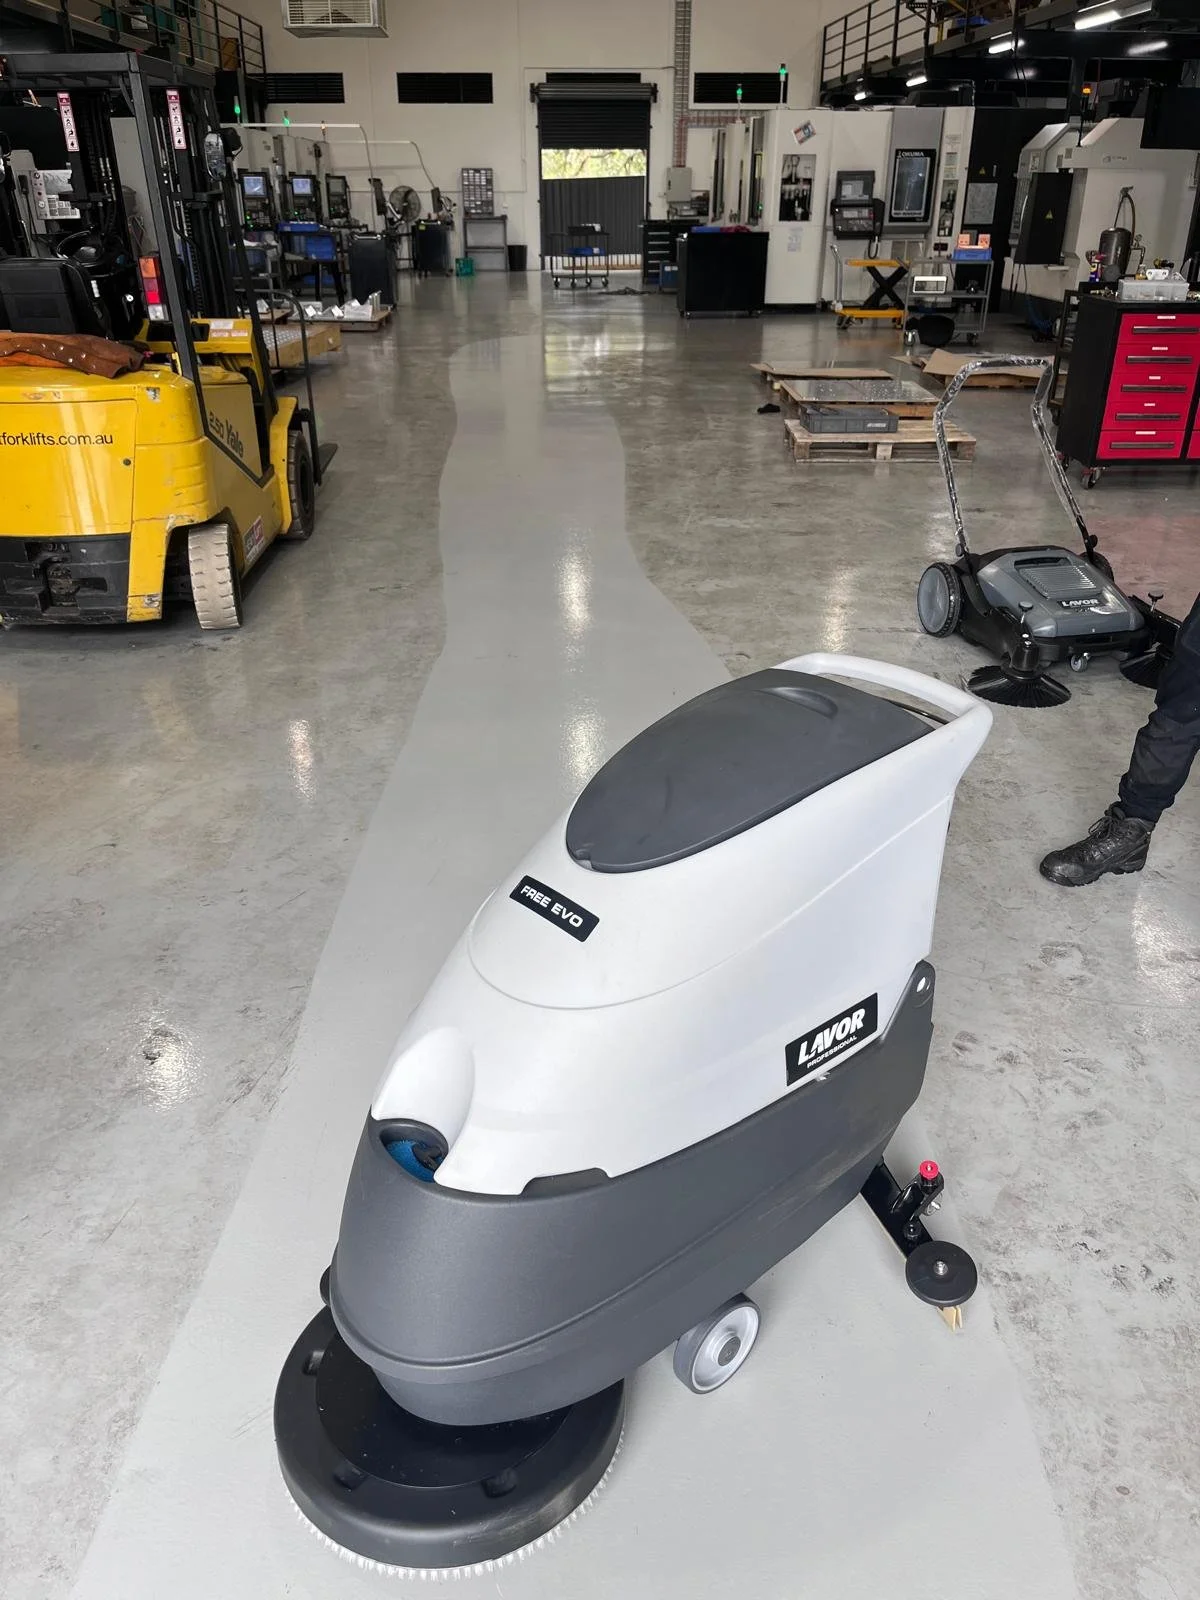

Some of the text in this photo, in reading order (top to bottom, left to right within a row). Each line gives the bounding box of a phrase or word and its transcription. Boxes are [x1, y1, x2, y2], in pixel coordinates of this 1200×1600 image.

[225, 419, 244, 459] Yale
[1062, 599, 1098, 607] LAVOR
[520, 885, 584, 928] FREE EVO
[797, 1008, 866, 1066] LAVOR
[806, 1035, 858, 1069] PROFESSIONAL
